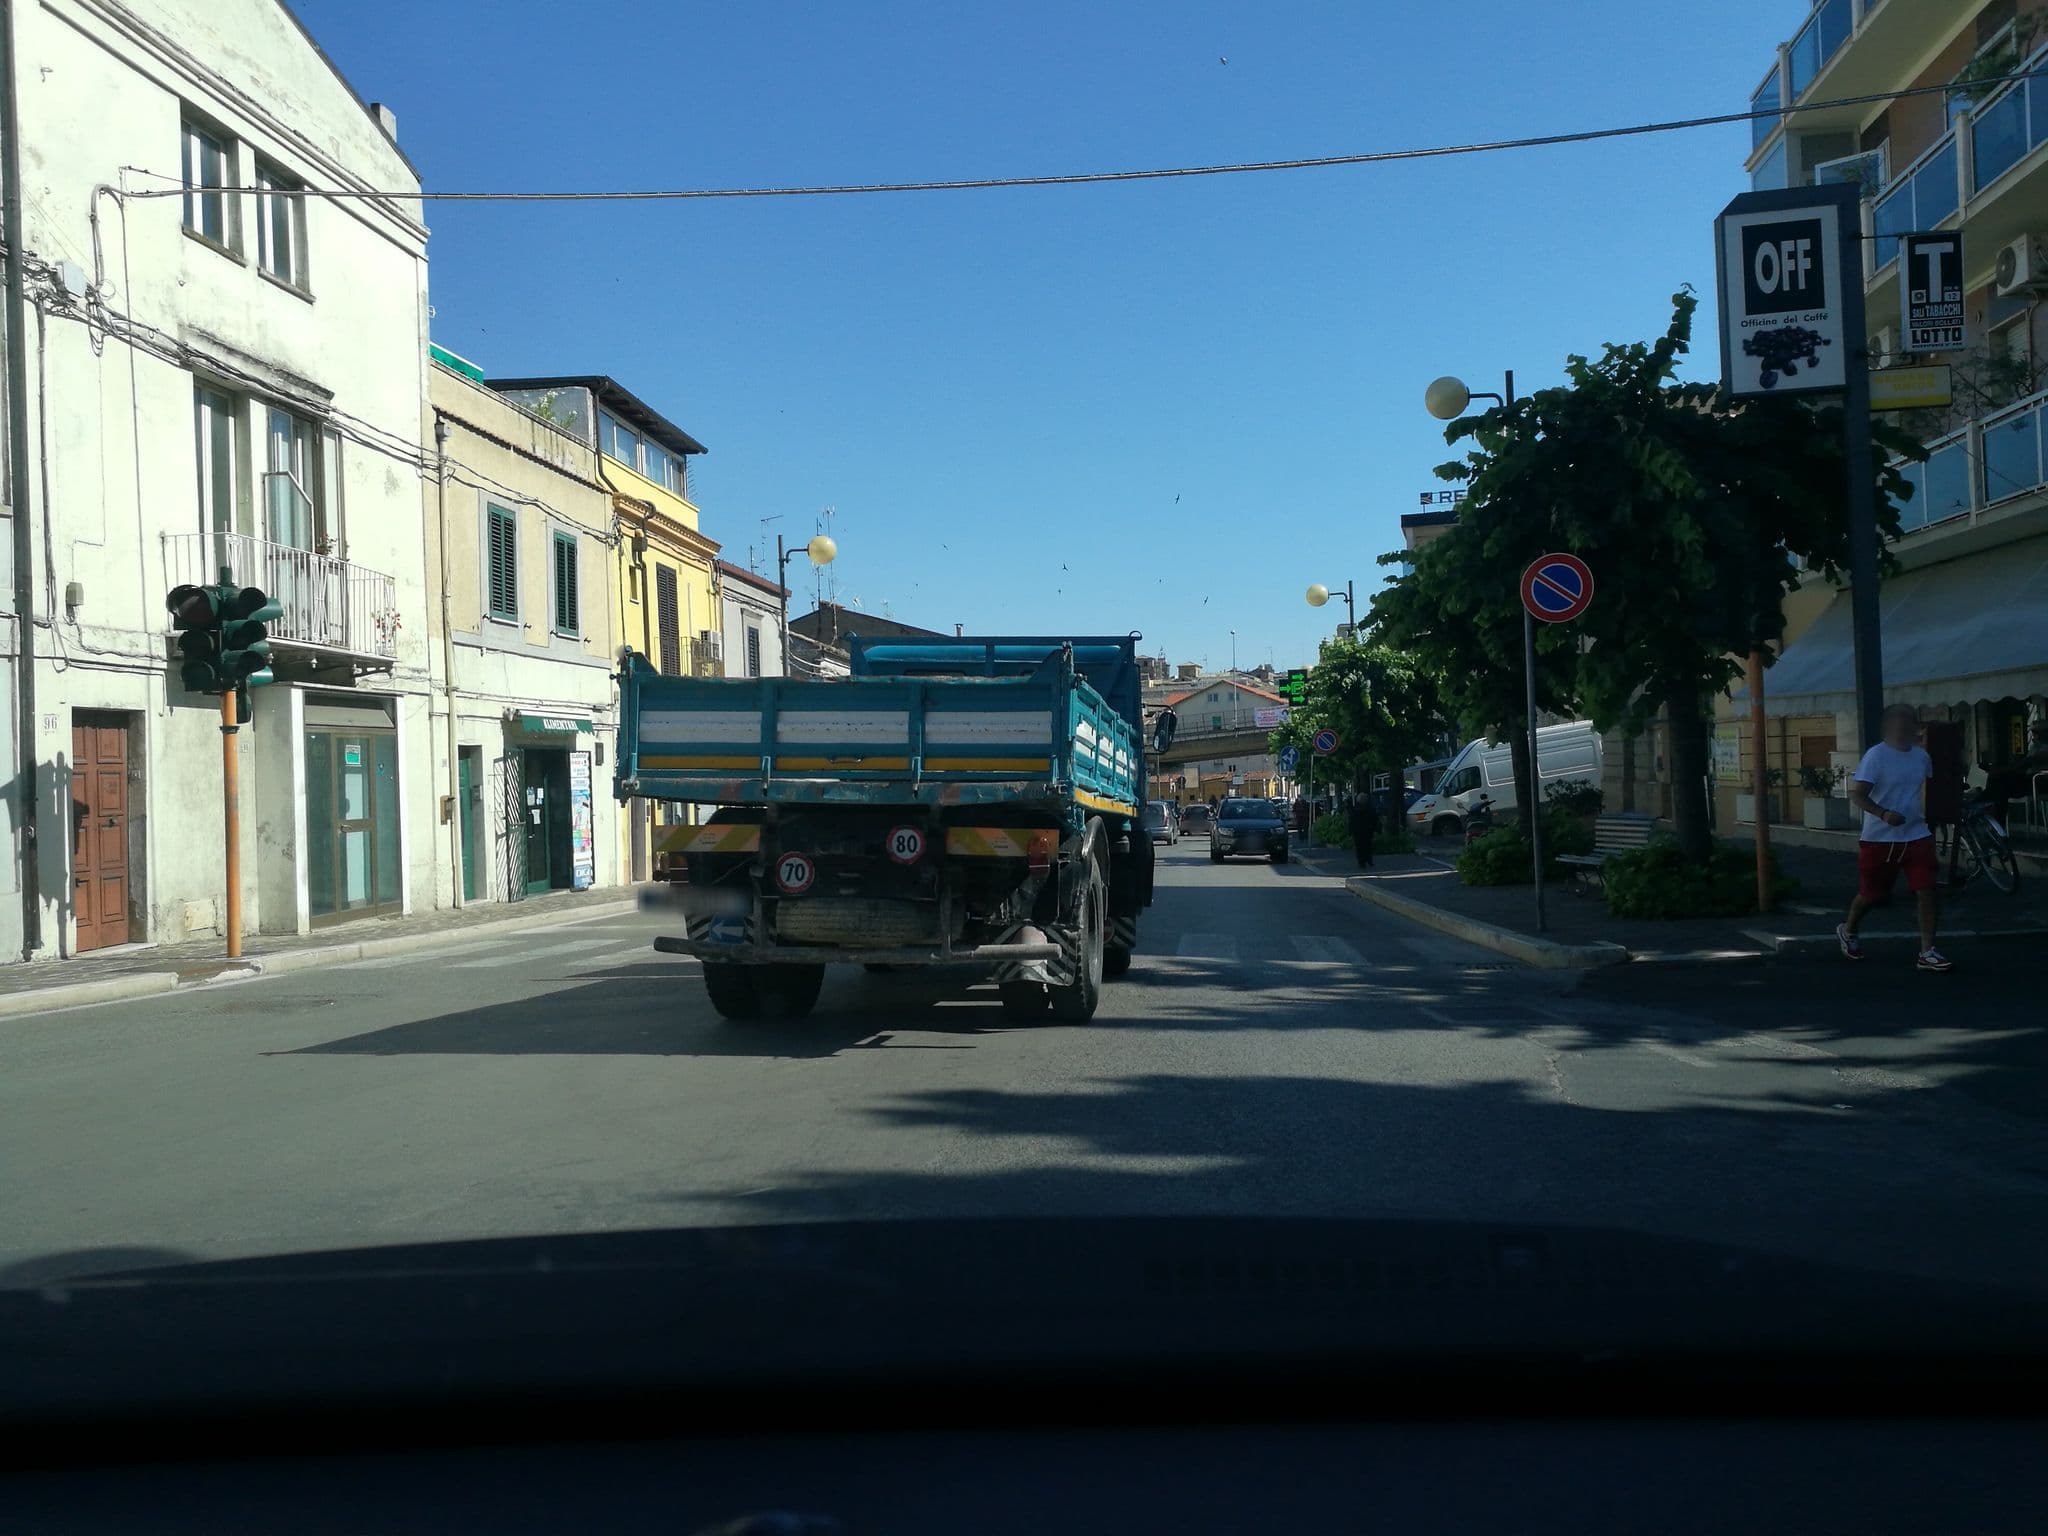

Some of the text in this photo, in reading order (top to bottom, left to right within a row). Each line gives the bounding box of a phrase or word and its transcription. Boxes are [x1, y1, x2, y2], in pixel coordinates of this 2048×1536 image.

[1755, 238, 1811, 294] OFF
[1915, 242, 1954, 303] T
[1925, 303, 1961, 317] TABACCHI
[1741, 319, 1777, 328] Officina
[1783, 313, 1798, 324] del
[1912, 327, 1962, 344] LOTTO
[43, 716, 58, 731] 96
[896, 835, 918, 853] 80
[785, 863, 805, 882] 70
